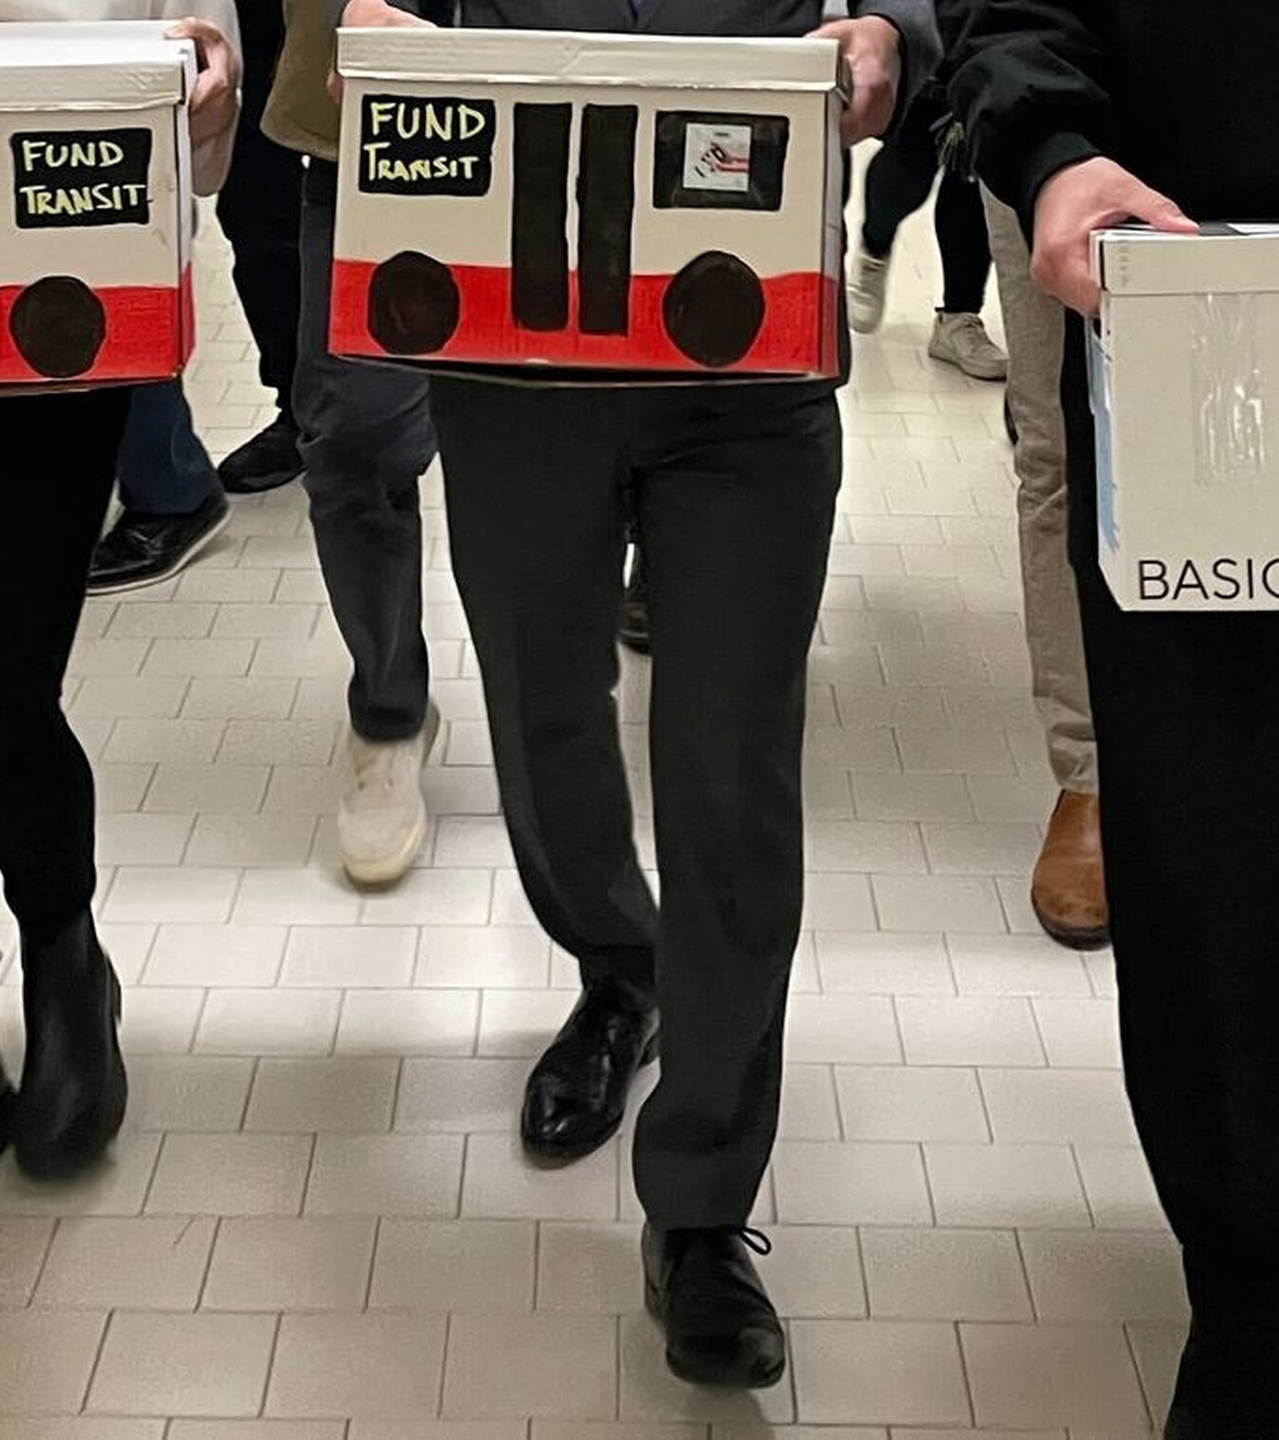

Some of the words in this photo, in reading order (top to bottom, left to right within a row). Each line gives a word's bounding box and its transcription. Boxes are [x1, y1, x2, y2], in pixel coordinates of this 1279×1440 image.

[370, 102, 486, 141] FUND
[22, 140, 124, 172] FUND
[19, 183, 147, 216] TRANSIT
